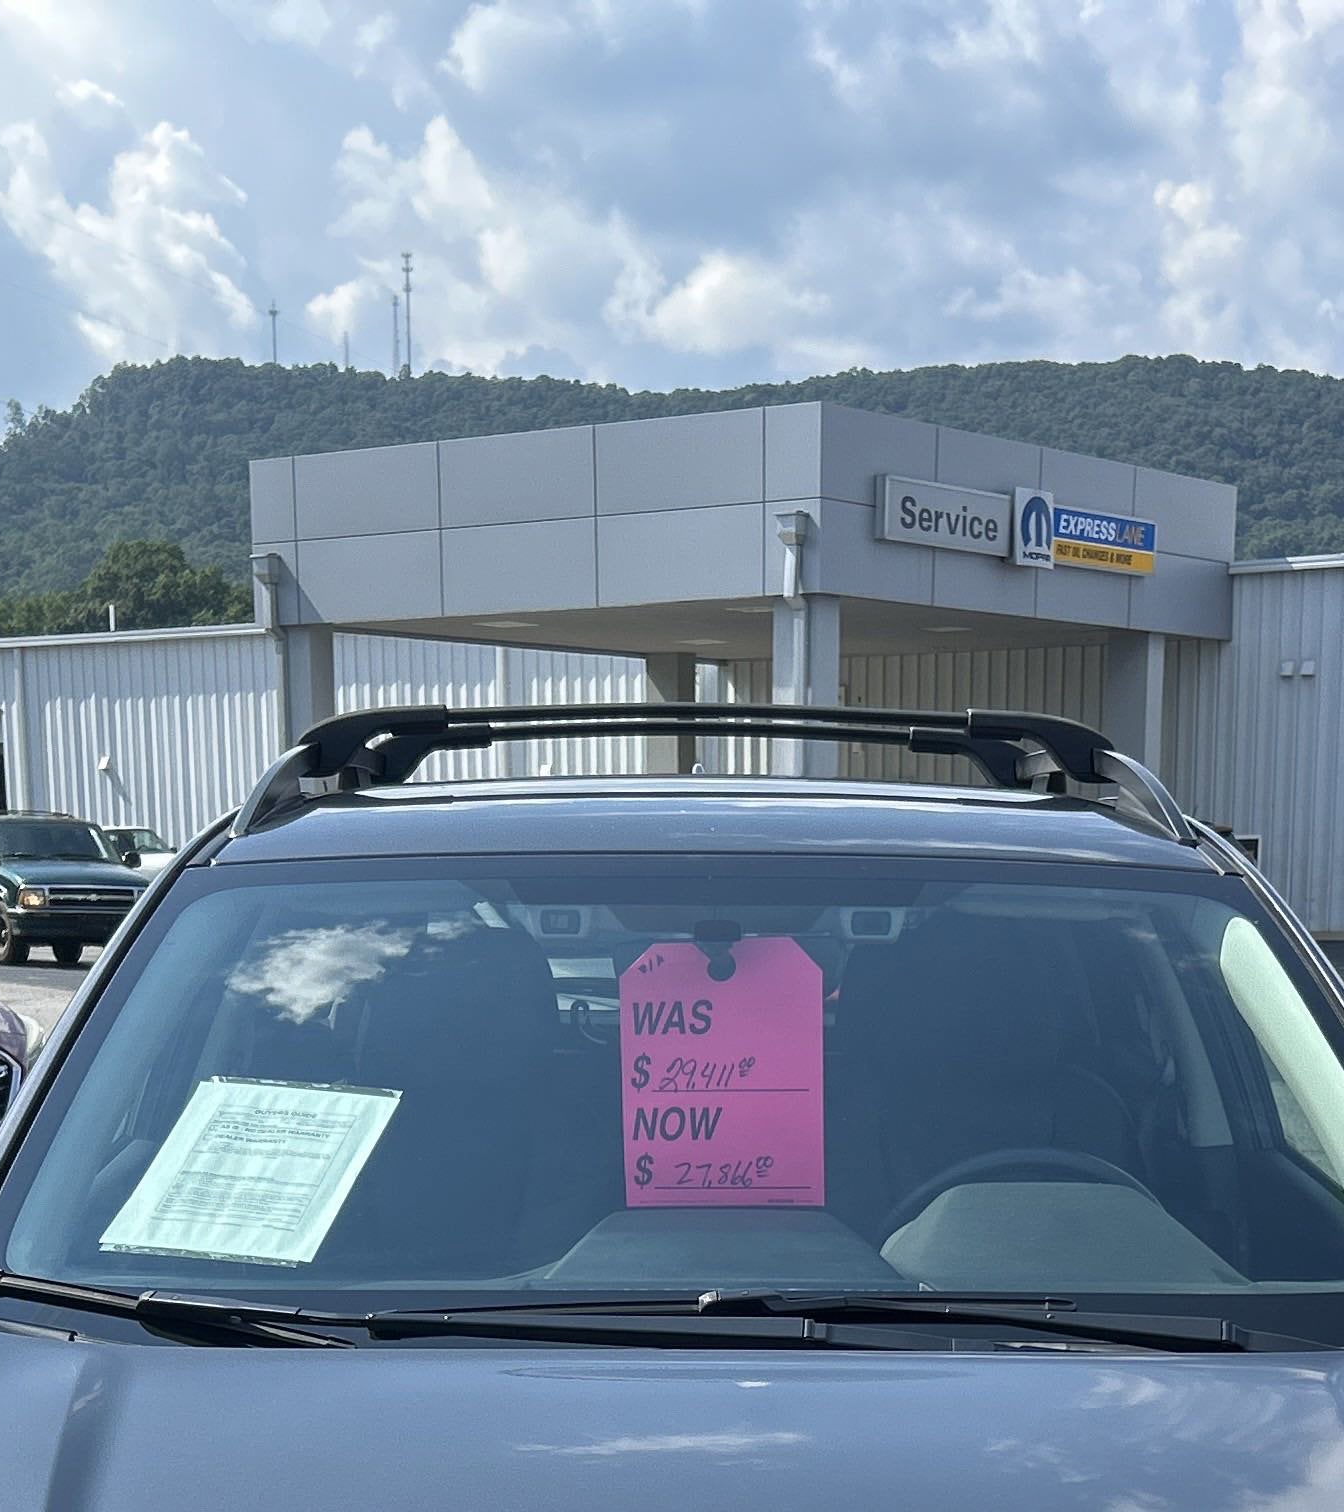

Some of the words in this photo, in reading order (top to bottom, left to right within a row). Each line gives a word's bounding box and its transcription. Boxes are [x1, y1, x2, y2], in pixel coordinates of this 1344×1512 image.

[900, 496, 999, 542] Service
[631, 999, 713, 1036] WAS
[631, 1052, 651, 1093] $
[632, 1106, 723, 1141] NOW
[634, 1152, 654, 1190] $
